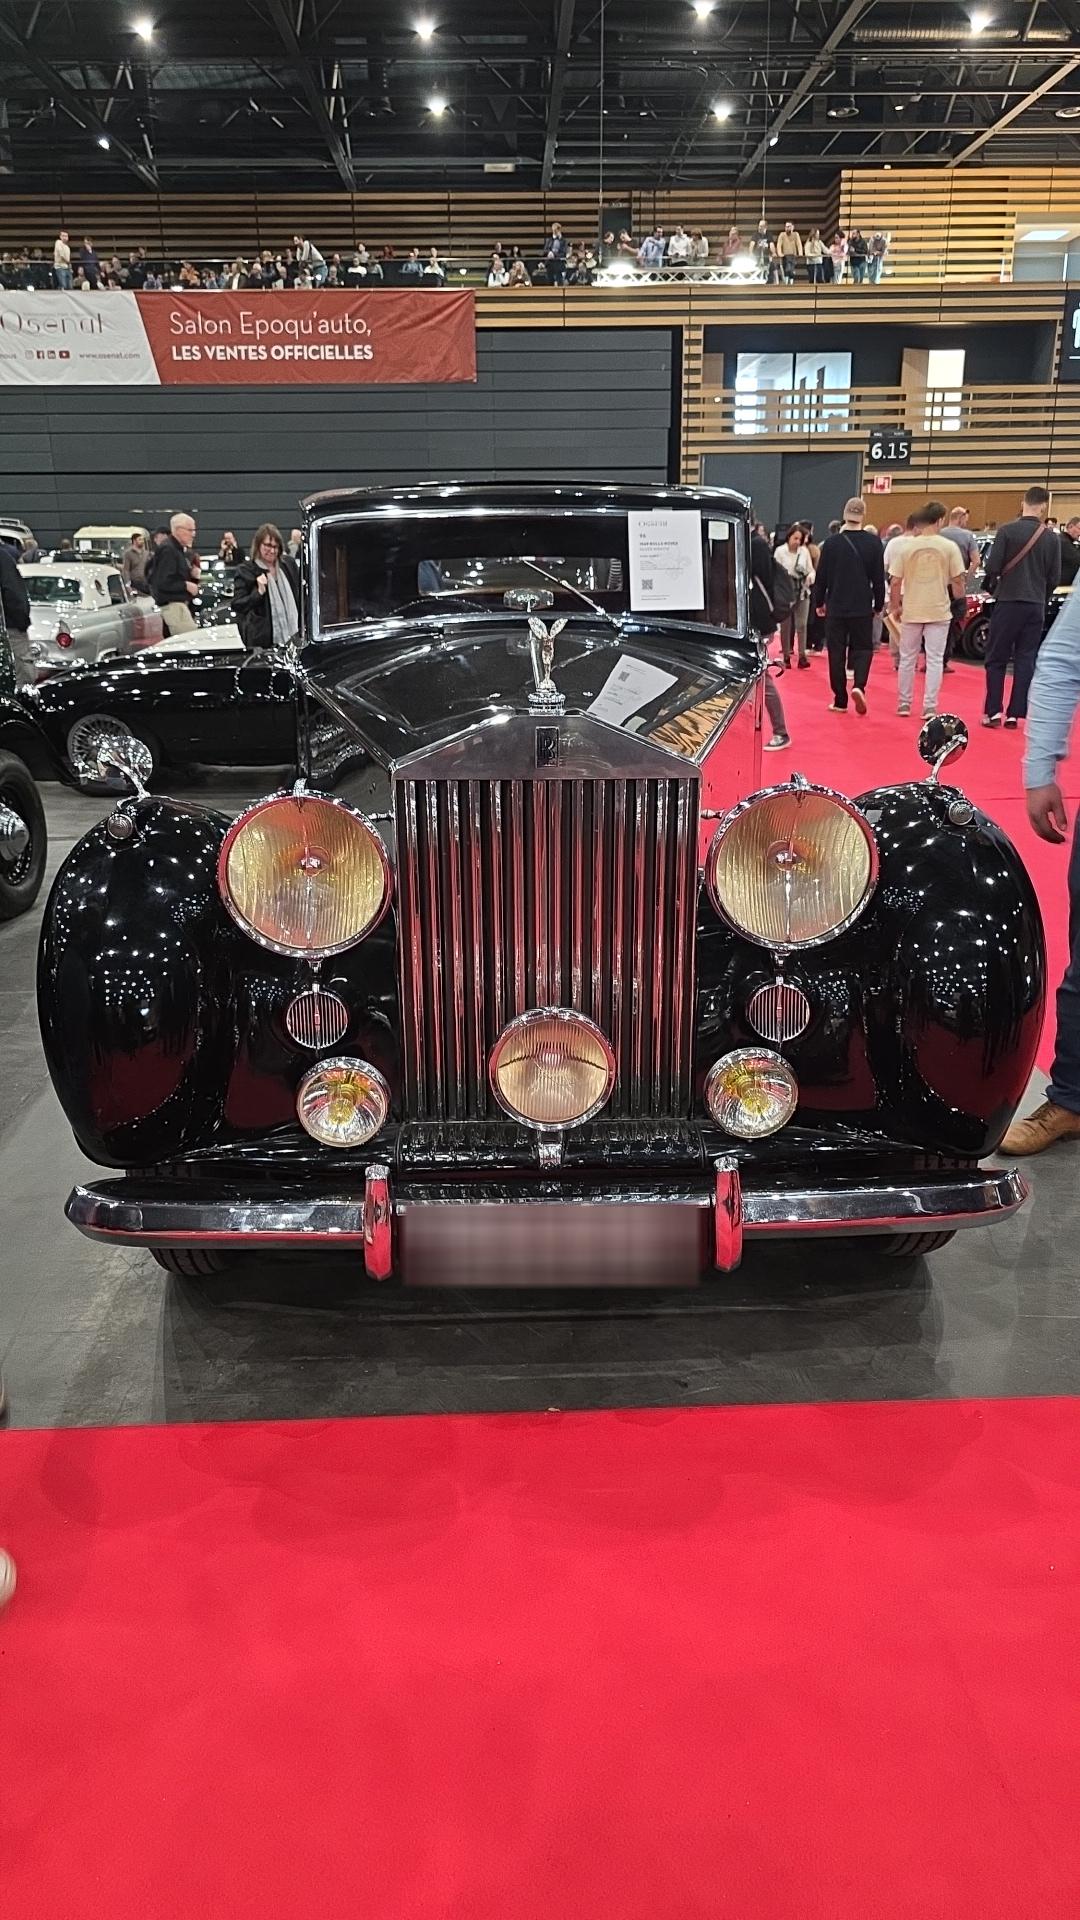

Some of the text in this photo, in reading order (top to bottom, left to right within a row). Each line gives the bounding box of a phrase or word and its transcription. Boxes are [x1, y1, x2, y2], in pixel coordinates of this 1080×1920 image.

[170, 311, 372, 340] Salon Epoqu'auto,
[172, 344, 374, 361] LES VENTES OFFICIELLES
[871, 442, 909, 460] 6.15
